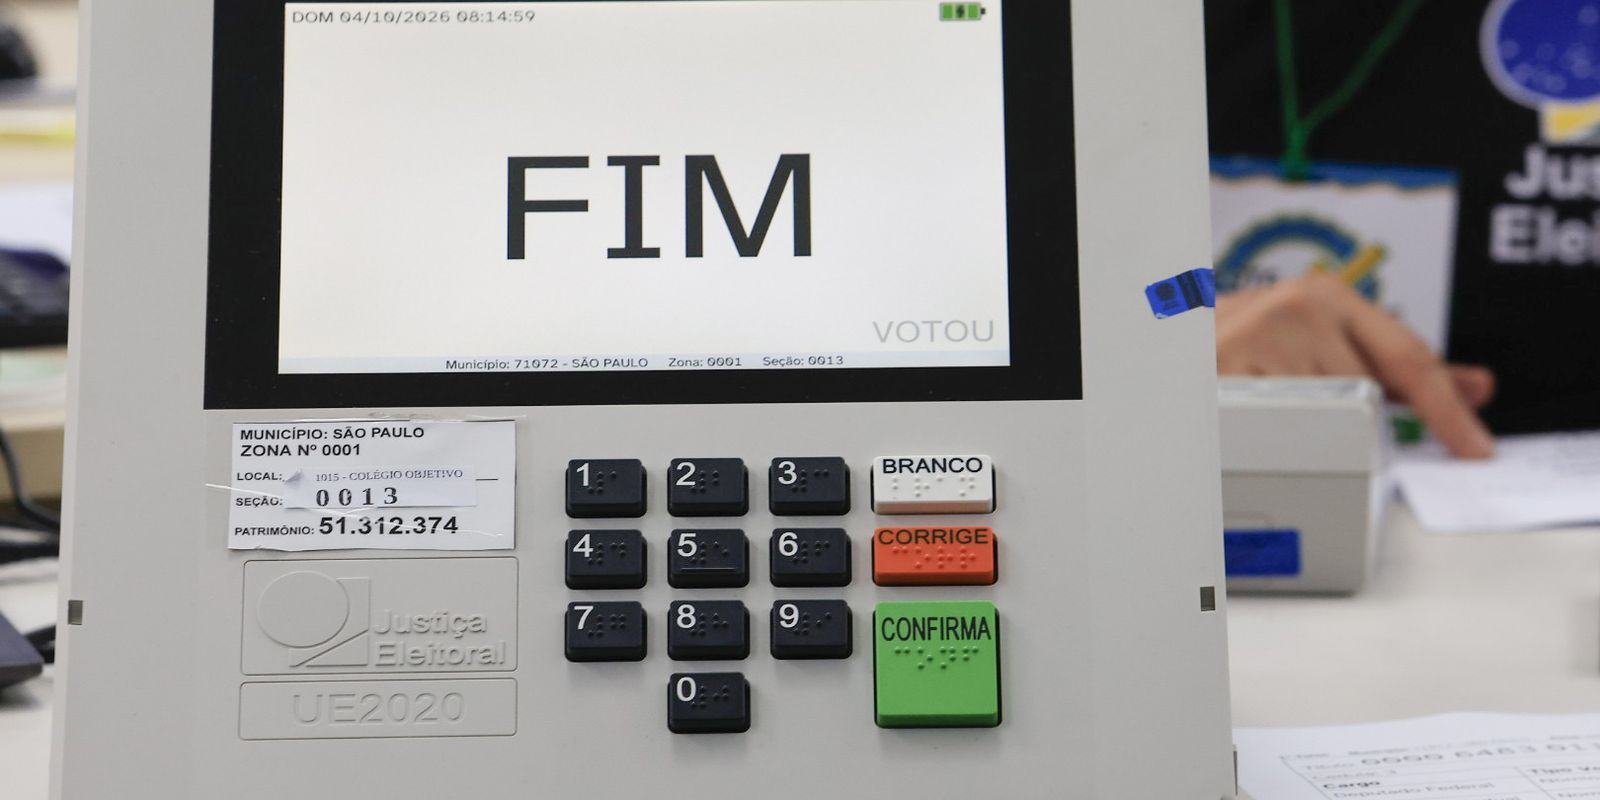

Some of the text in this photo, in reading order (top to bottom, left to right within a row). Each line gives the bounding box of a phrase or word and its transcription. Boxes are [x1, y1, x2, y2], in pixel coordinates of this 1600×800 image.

[292, 10, 536, 24] DOM 04/10/2026 08:14:59
[507, 153, 812, 260] FIM
[872, 319, 994, 343] VOTOU
[445, 359, 510, 370] Município:
[514, 358, 558, 369] 71072
[571, 356, 600, 368] SÃO
[603, 357, 649, 368] PAULO
[668, 356, 742, 367] Zona: 0001
[762, 355, 844, 367] Seção: 0013
[240, 426, 425, 441] MUNICÍPIO: SÃO PAULO
[240, 444, 361, 457] ZONA Nº 0001
[236, 472, 283, 481] LOCAL:
[315, 473, 340, 482] 1015
[348, 469, 402, 481] COLÉGIO
[405, 469, 463, 479] OBJETIVO
[576, 462, 590, 486] 1
[675, 461, 697, 486] 2
[777, 460, 798, 486] 3
[882, 457, 984, 475] BRANCO
[235, 495, 284, 508] SEÇÃO:
[234, 516, 459, 536] PATRIMÔNIO: 51.312.374
[878, 528, 989, 545] CORRIGE
[572, 533, 594, 557] 4
[676, 532, 698, 557] 5
[777, 531, 799, 557] 6
[374, 607, 488, 637] Justiça
[573, 605, 594, 630] 7
[675, 604, 697, 630] 8
[778, 603, 799, 629] 9
[881, 616, 991, 642] CONFIRMA
[374, 641, 506, 669] Eleitoral
[675, 676, 697, 702] 0
[292, 691, 466, 726] UE2020
